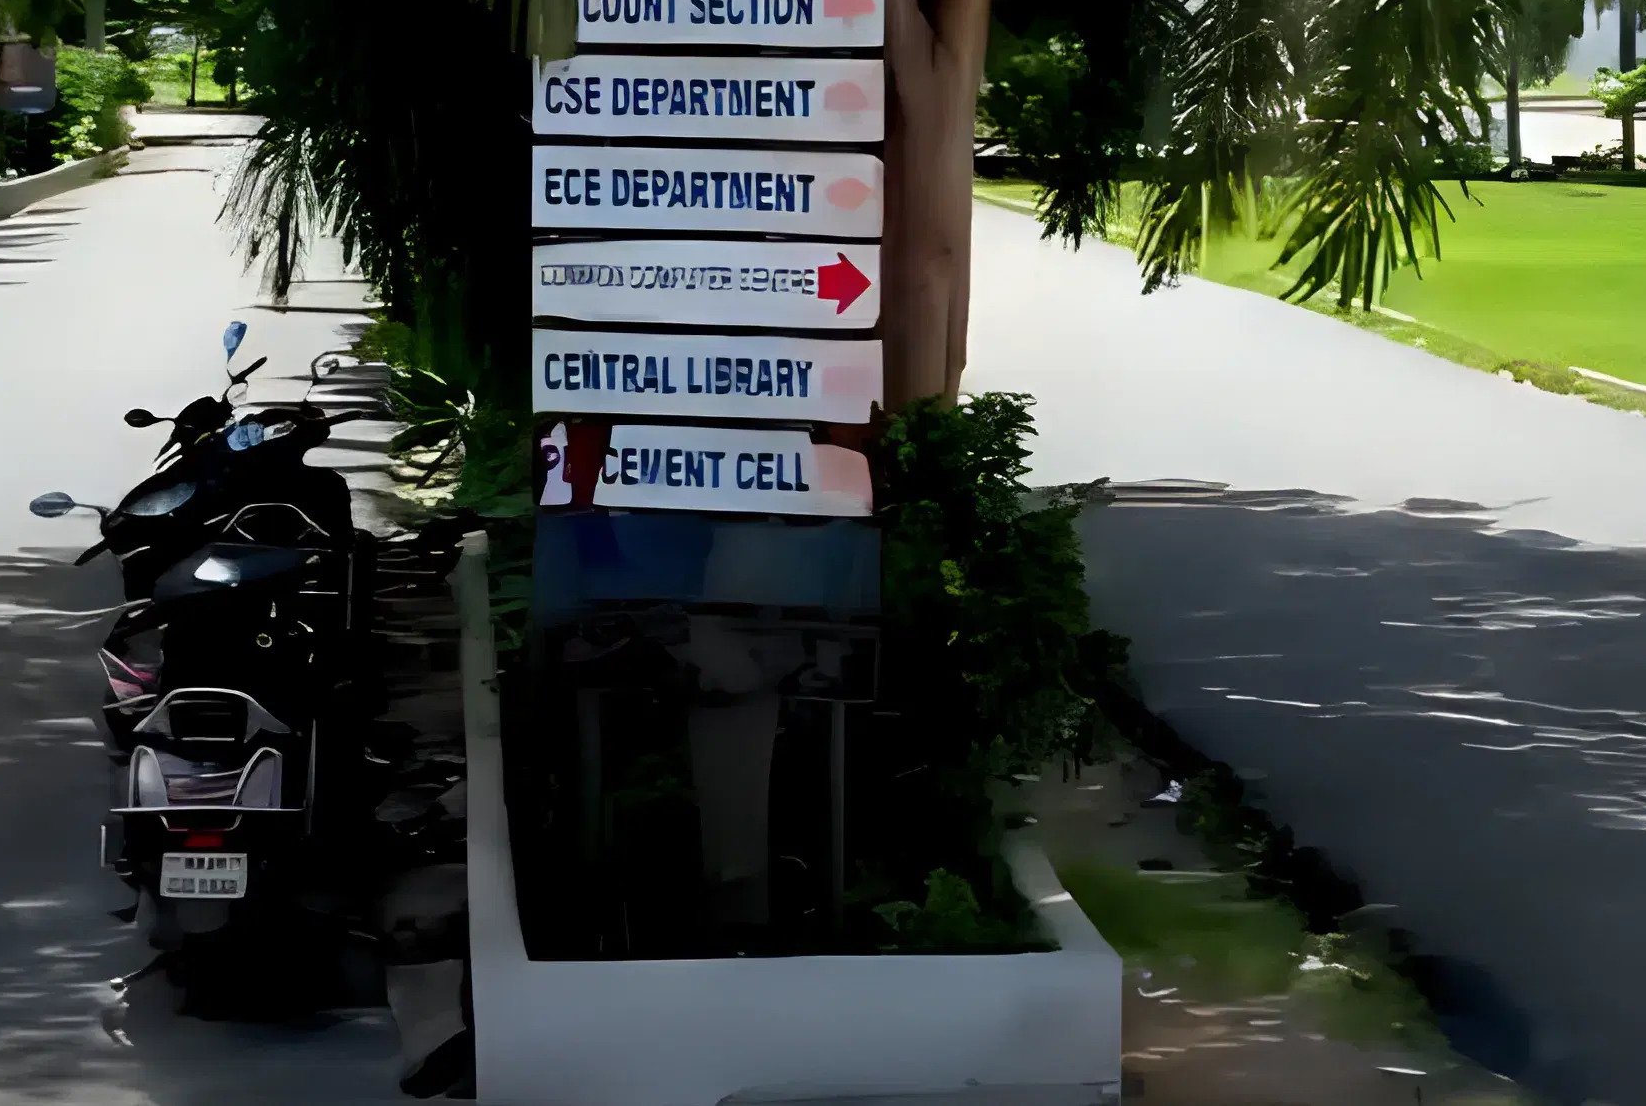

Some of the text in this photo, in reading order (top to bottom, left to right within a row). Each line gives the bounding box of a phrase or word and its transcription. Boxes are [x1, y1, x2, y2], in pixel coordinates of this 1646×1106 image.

[545, 76, 816, 117] CSE DEPARTMENT
[545, 168, 816, 213] ECE DEPARTMENT
[544, 352, 814, 398] CENTRAL LIBRARY
[736, 451, 810, 492] CELL
